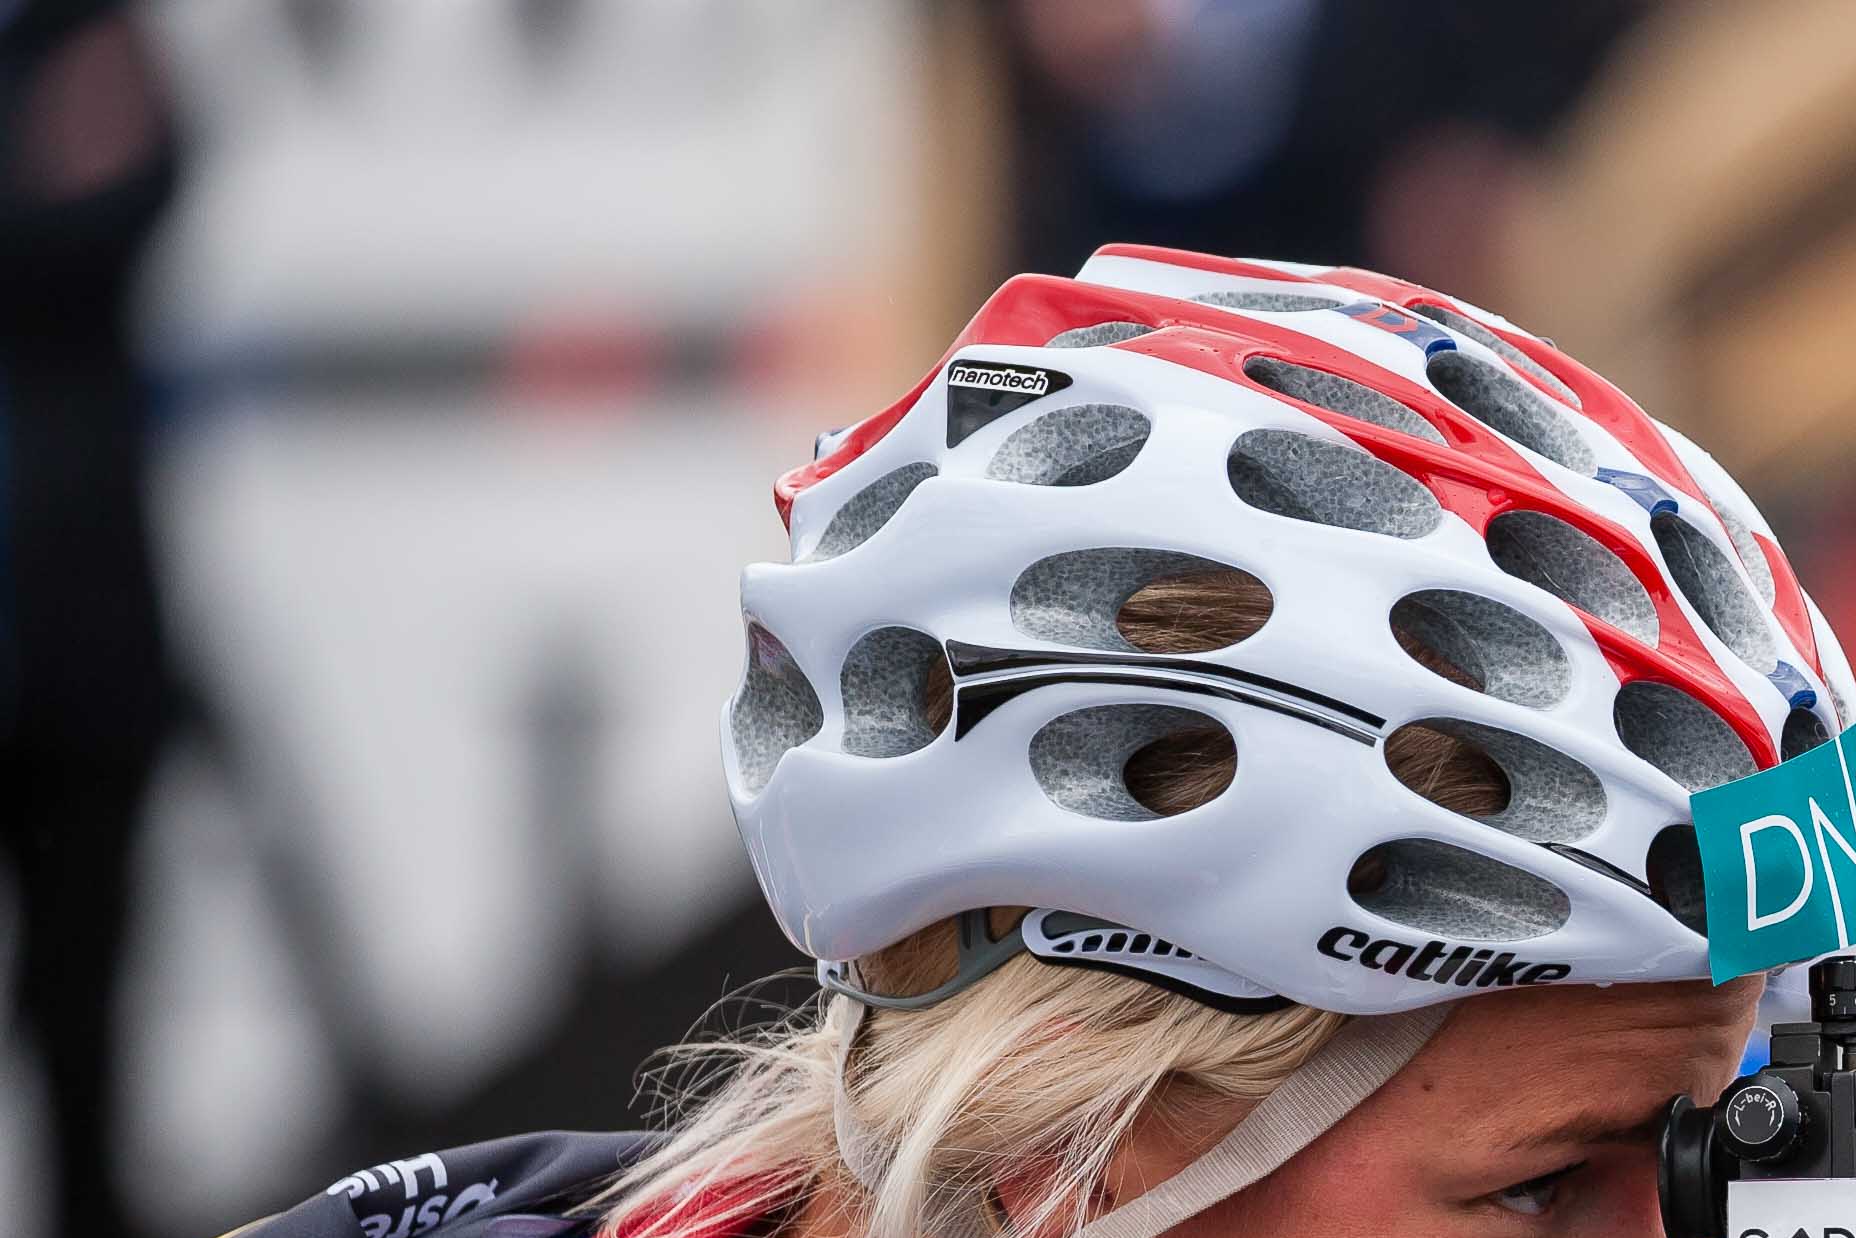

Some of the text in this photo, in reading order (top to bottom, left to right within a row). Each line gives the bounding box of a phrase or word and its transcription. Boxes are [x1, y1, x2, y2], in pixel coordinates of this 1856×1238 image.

[952, 369, 1046, 391] nanotech
[1316, 926, 1572, 987] catlike
[1828, 993, 1837, 1007] 5
